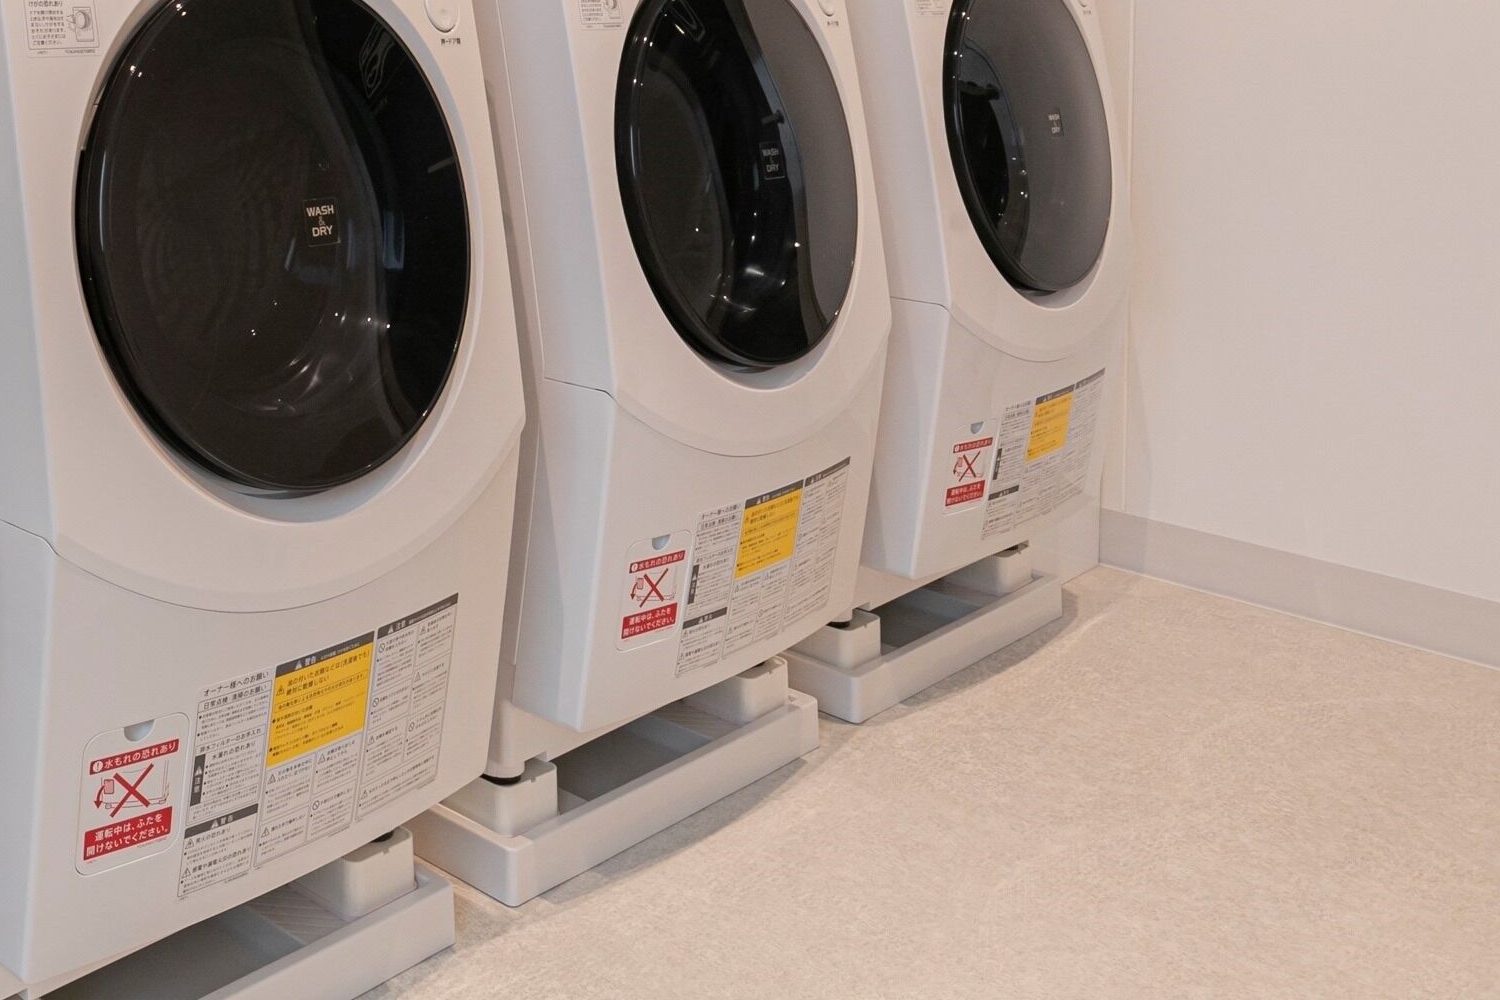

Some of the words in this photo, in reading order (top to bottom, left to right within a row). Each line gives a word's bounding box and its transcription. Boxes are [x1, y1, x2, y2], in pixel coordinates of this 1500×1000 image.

[306, 204, 335, 217] WASH
[311, 225, 333, 238] DRY
[103, 741, 178, 770] 水もれの恐れあり
[86, 825, 169, 857] 開けないでください。
[94, 813, 164, 842] 運転中は、ふたを
